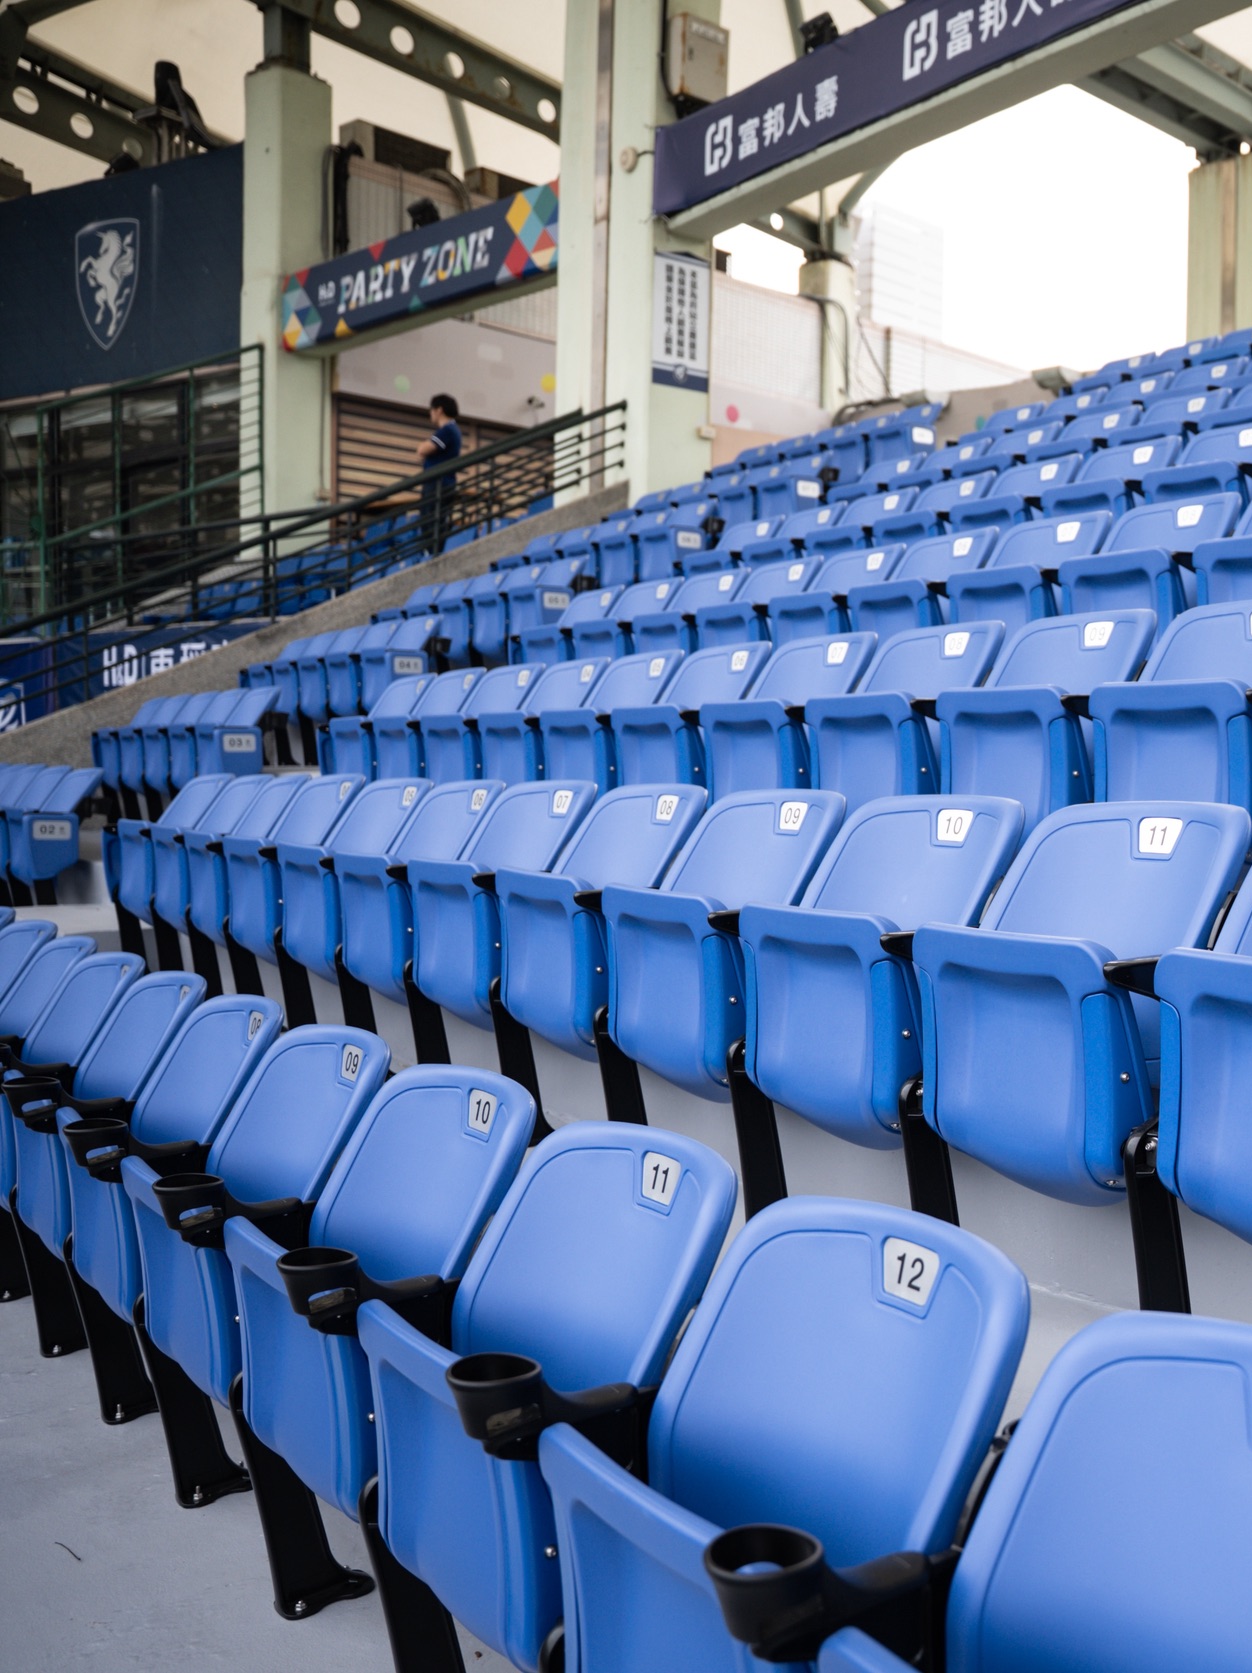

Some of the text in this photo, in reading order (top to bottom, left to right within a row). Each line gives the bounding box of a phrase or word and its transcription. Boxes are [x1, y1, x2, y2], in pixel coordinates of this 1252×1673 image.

[946, 0, 1072, 60] 富邦人
[738, 75, 838, 161] 富邦人壽
[337, 252, 418, 314] PARTY
[419, 226, 494, 288] ZONE
[1090, 626, 1106, 641] 09
[830, 646, 844, 659] 07
[948, 637, 964, 651] 08
[734, 655, 745, 667] 06
[228, 737, 243, 748] 03
[404, 790, 414, 802] 05
[473, 793, 484, 806] 06
[556, 795, 569, 809] 07
[659, 800, 674, 816] 08
[784, 807, 801, 825] 09
[39, 824, 56, 835] 02
[946, 816, 963, 835] 10
[1150, 825, 1168, 846] 11
[345, 1051, 359, 1074] 09
[475, 1099, 491, 1125] 10
[651, 1163, 670, 1194] 11
[897, 1253, 925, 1292] 12
